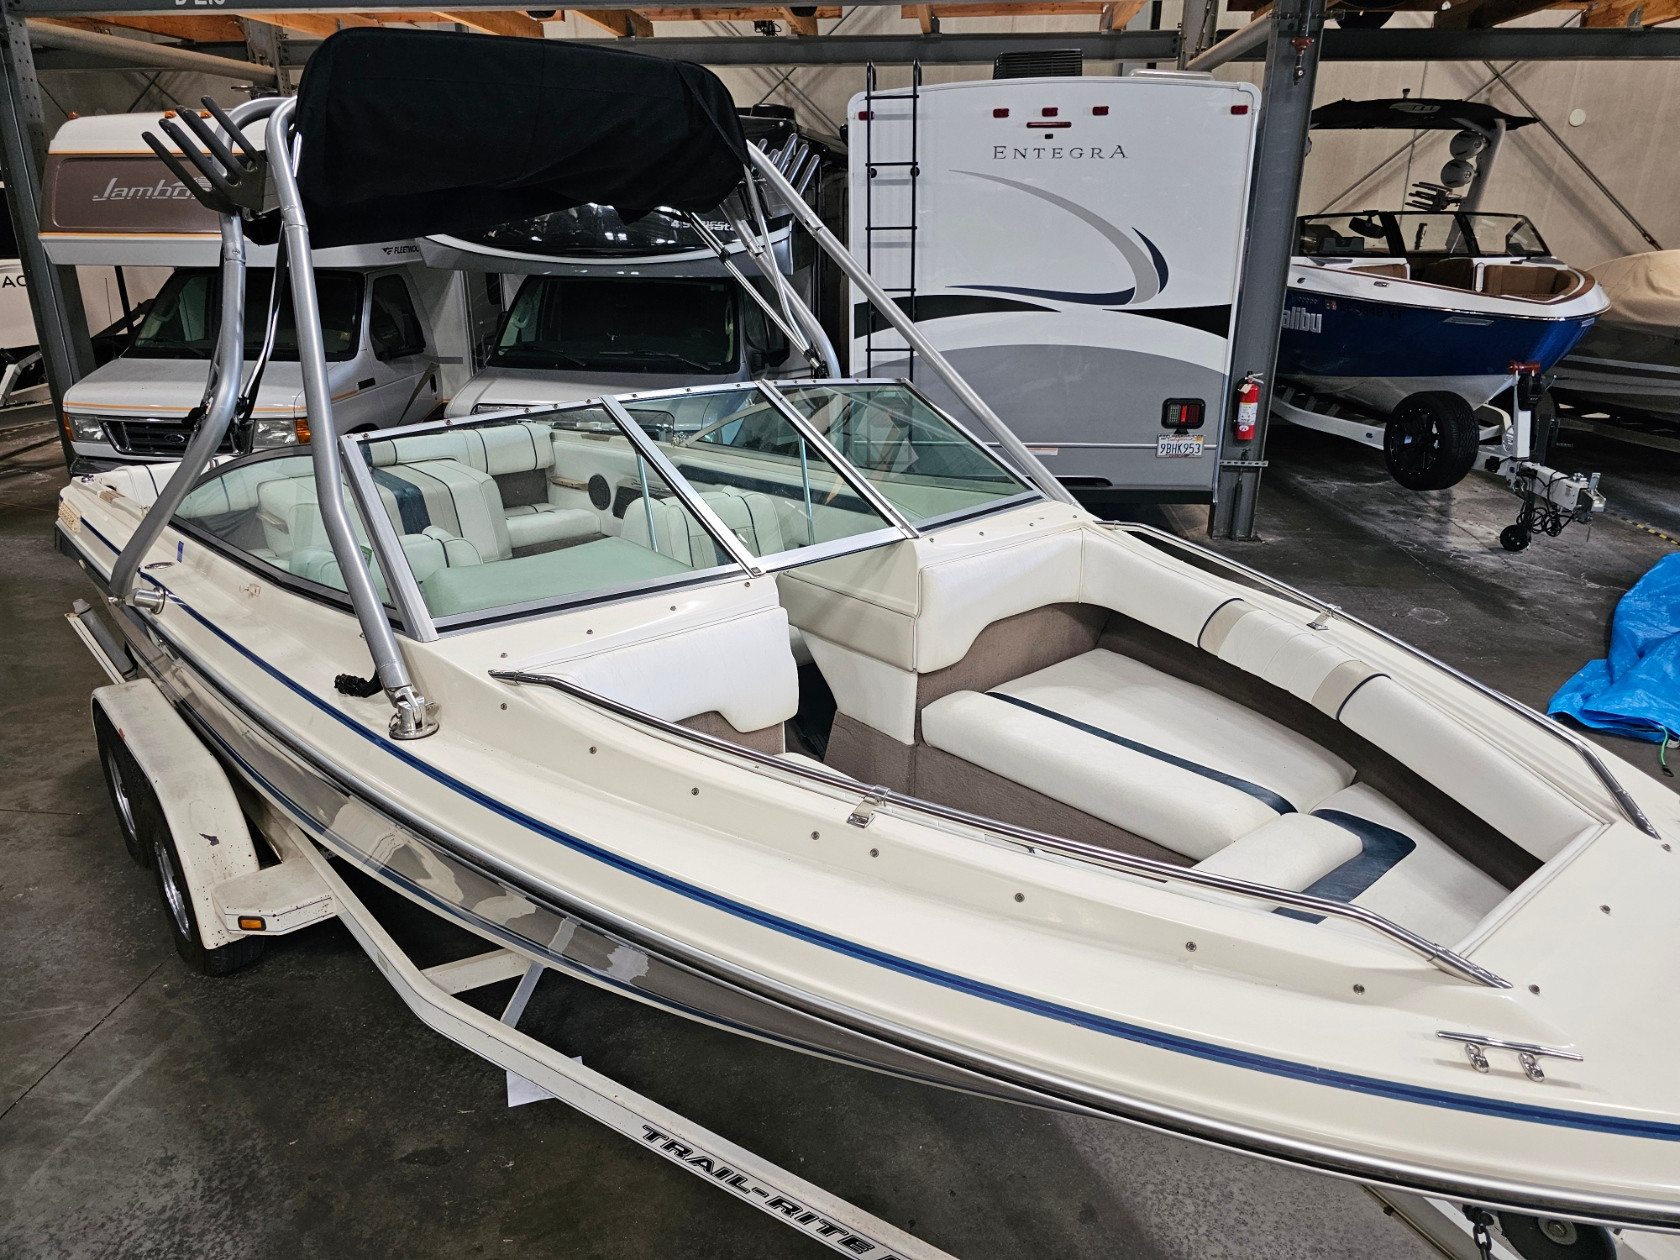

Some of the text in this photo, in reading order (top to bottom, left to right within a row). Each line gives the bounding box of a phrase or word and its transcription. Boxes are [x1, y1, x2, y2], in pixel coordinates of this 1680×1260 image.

[993, 145, 1128, 160] ENTEGRA
[92, 177, 196, 201] Jambo
[394, 245, 419, 254] FLEETWO
[1281, 306, 1322, 333] alibu
[1160, 442, 1201, 454] 9BHK953
[642, 1124, 875, 1255] TRAIL-RITE
